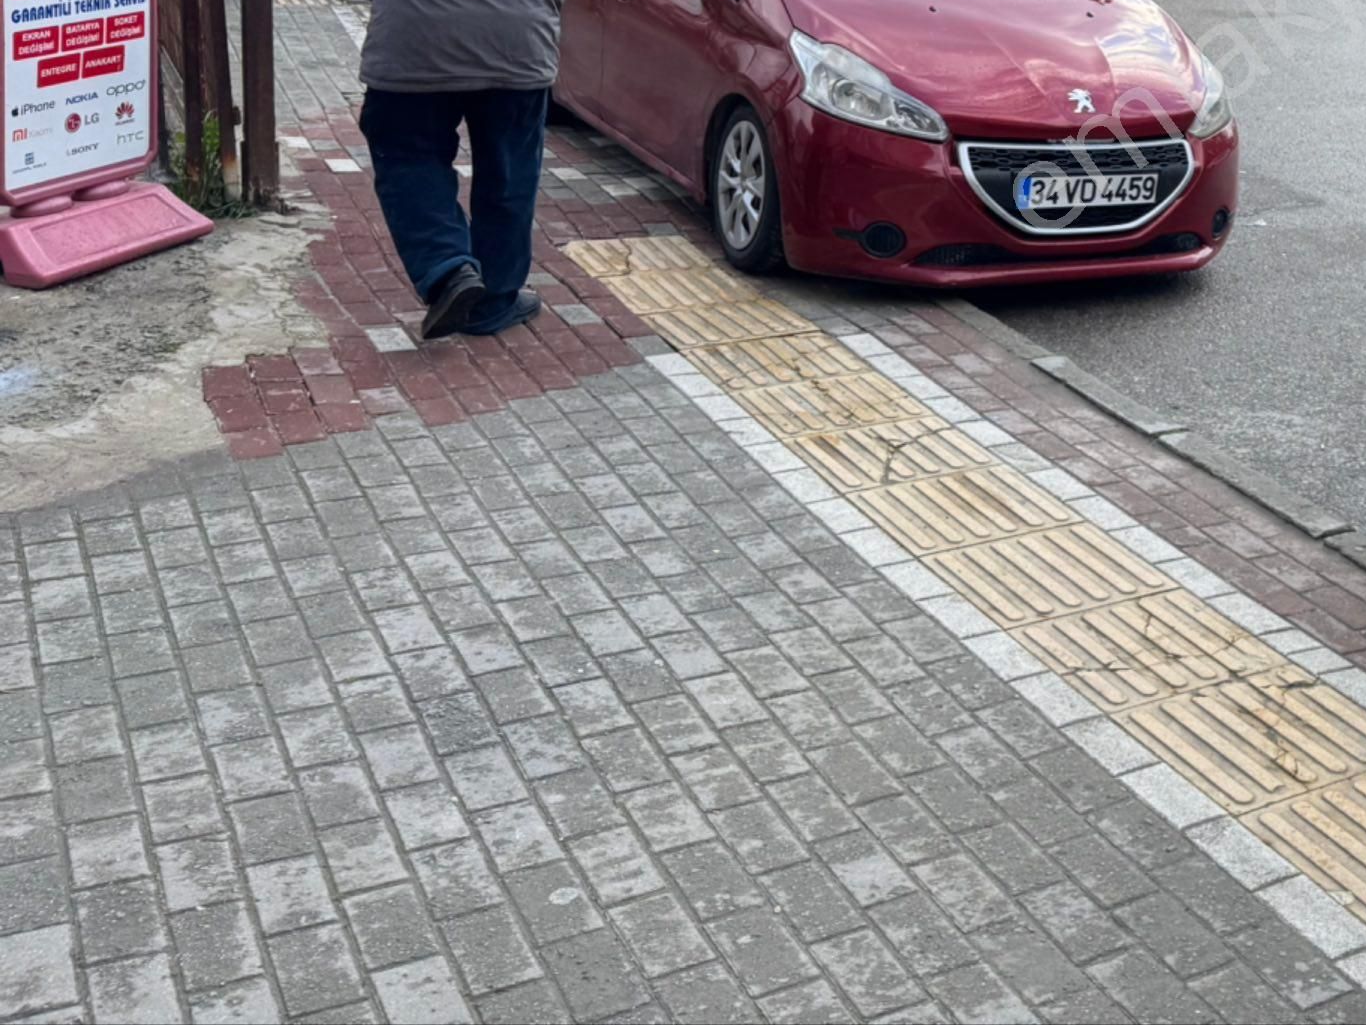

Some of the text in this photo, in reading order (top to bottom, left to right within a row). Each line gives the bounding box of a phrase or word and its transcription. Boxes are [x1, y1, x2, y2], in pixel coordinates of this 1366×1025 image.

[66, 21, 100, 34] BATARYA
[22, 30, 51, 42] EKRAN
[85, 55, 121, 69] ANAKART
[41, 63, 77, 78] ENTEGRE
[65, 91, 98, 106] NOKIA
[20, 100, 55, 116] iPhone
[84, 112, 100, 125] LG
[71, 142, 99, 155] SONY
[1031, 177, 1156, 206] 34 VD 4459
